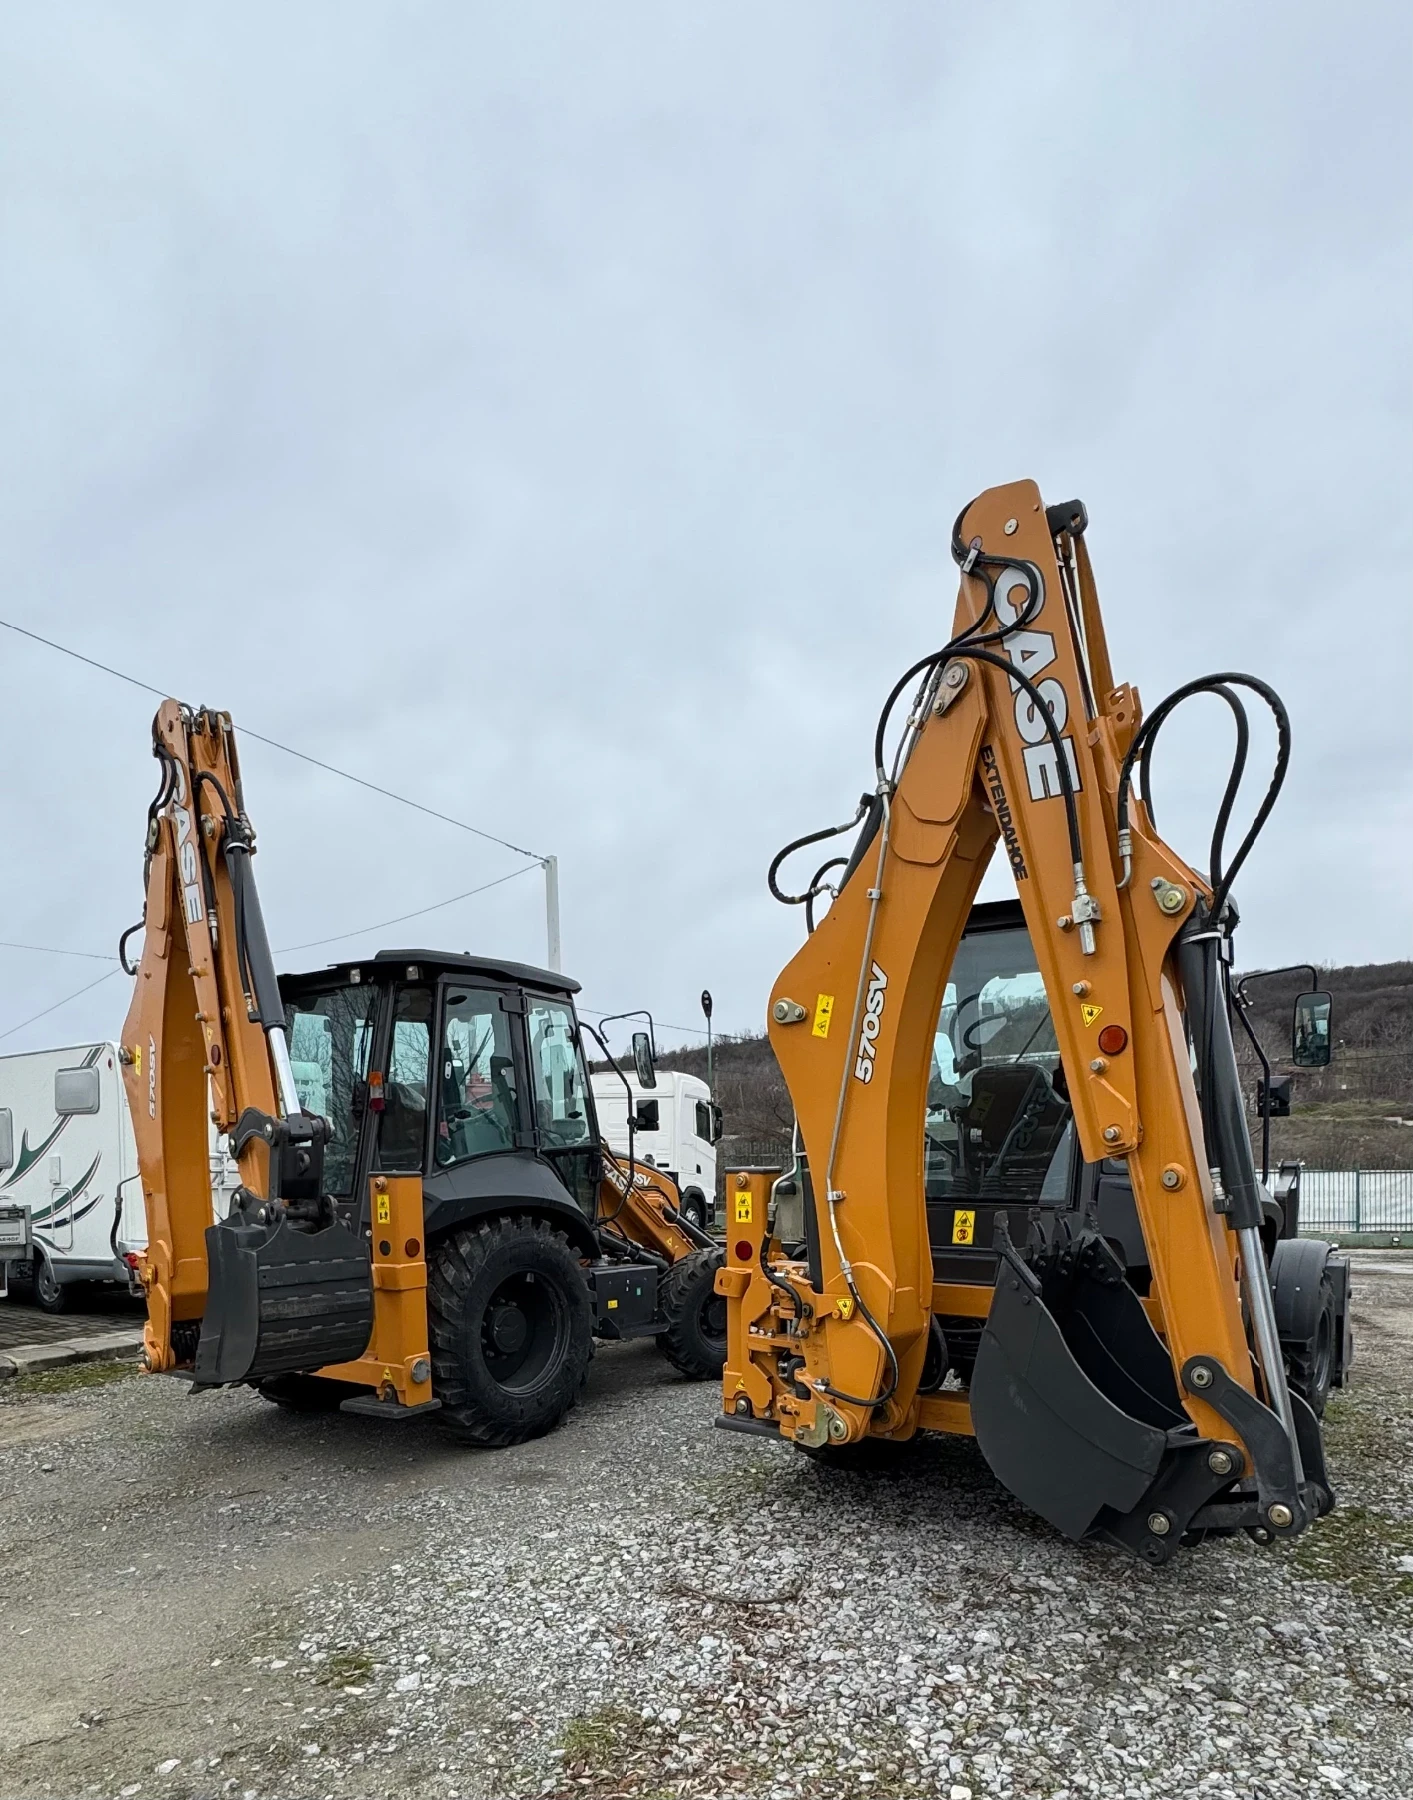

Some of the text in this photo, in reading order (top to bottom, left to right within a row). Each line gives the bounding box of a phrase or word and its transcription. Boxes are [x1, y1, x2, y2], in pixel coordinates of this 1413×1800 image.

[994, 560, 1083, 802] CASE
[981, 745, 1029, 881] EXTENDAHOE
[854, 959, 888, 1085] 570SV
